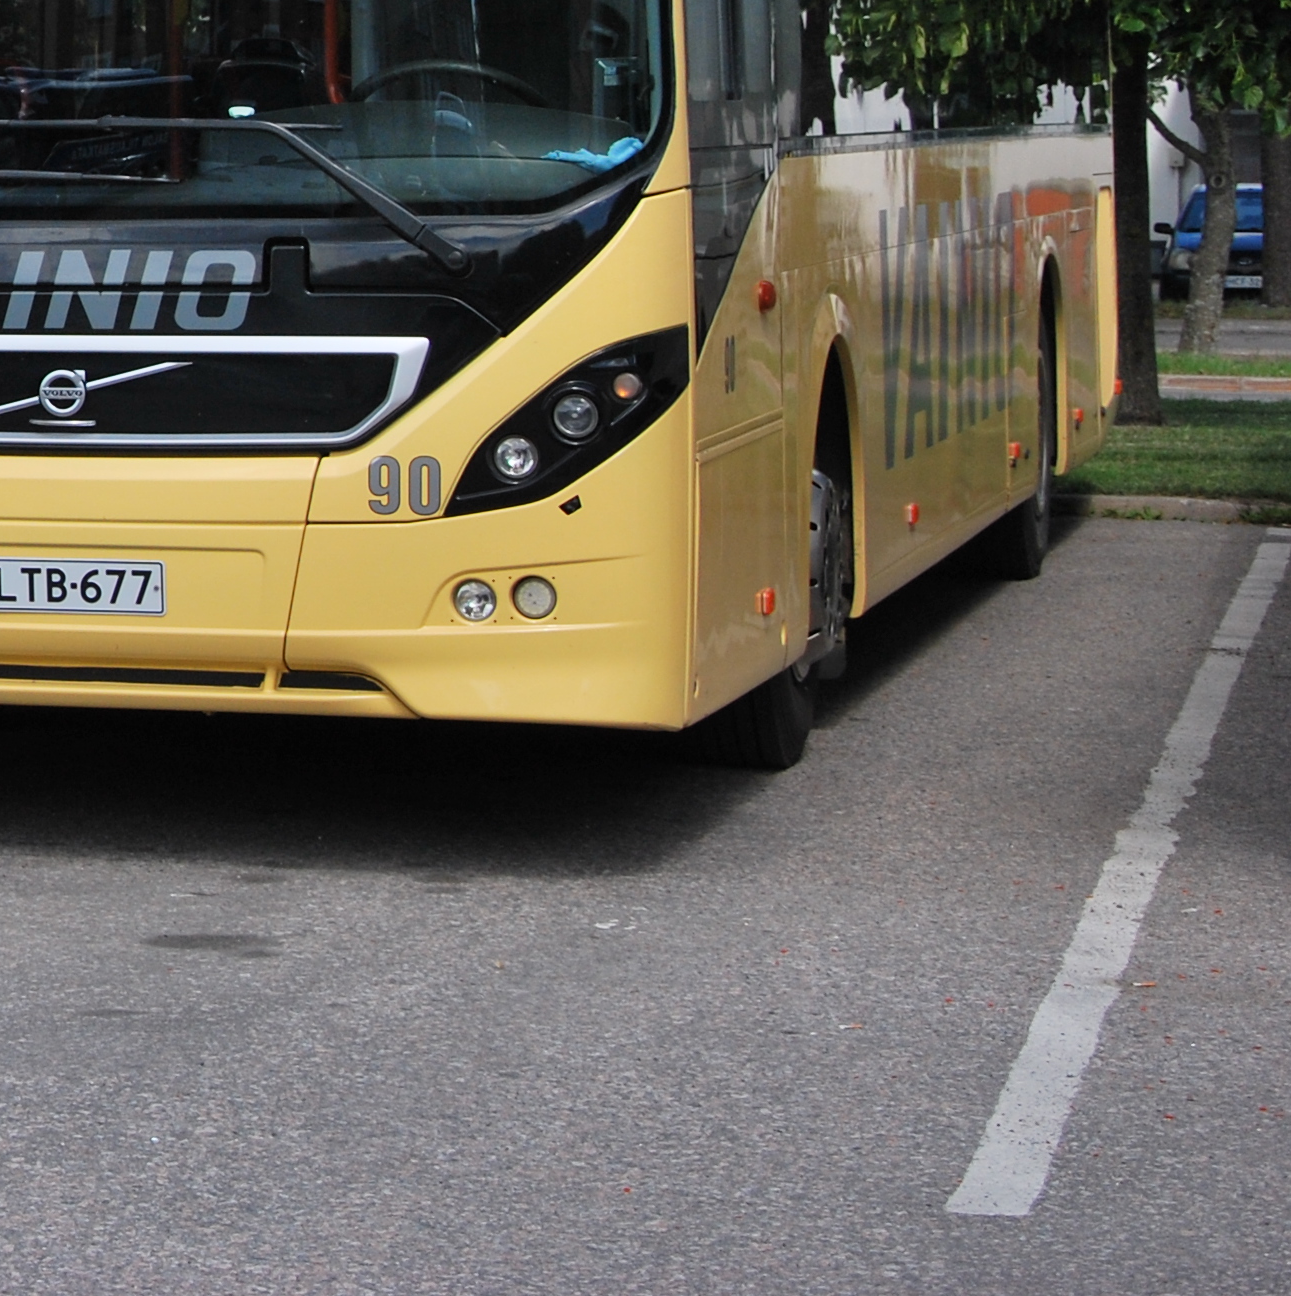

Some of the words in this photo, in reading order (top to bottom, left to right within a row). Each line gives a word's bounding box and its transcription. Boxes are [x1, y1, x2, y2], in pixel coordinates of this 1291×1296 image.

[878, 191, 1015, 471] VAINIO
[42, 389, 84, 398] VOLVO
[368, 455, 441, 516] 90
